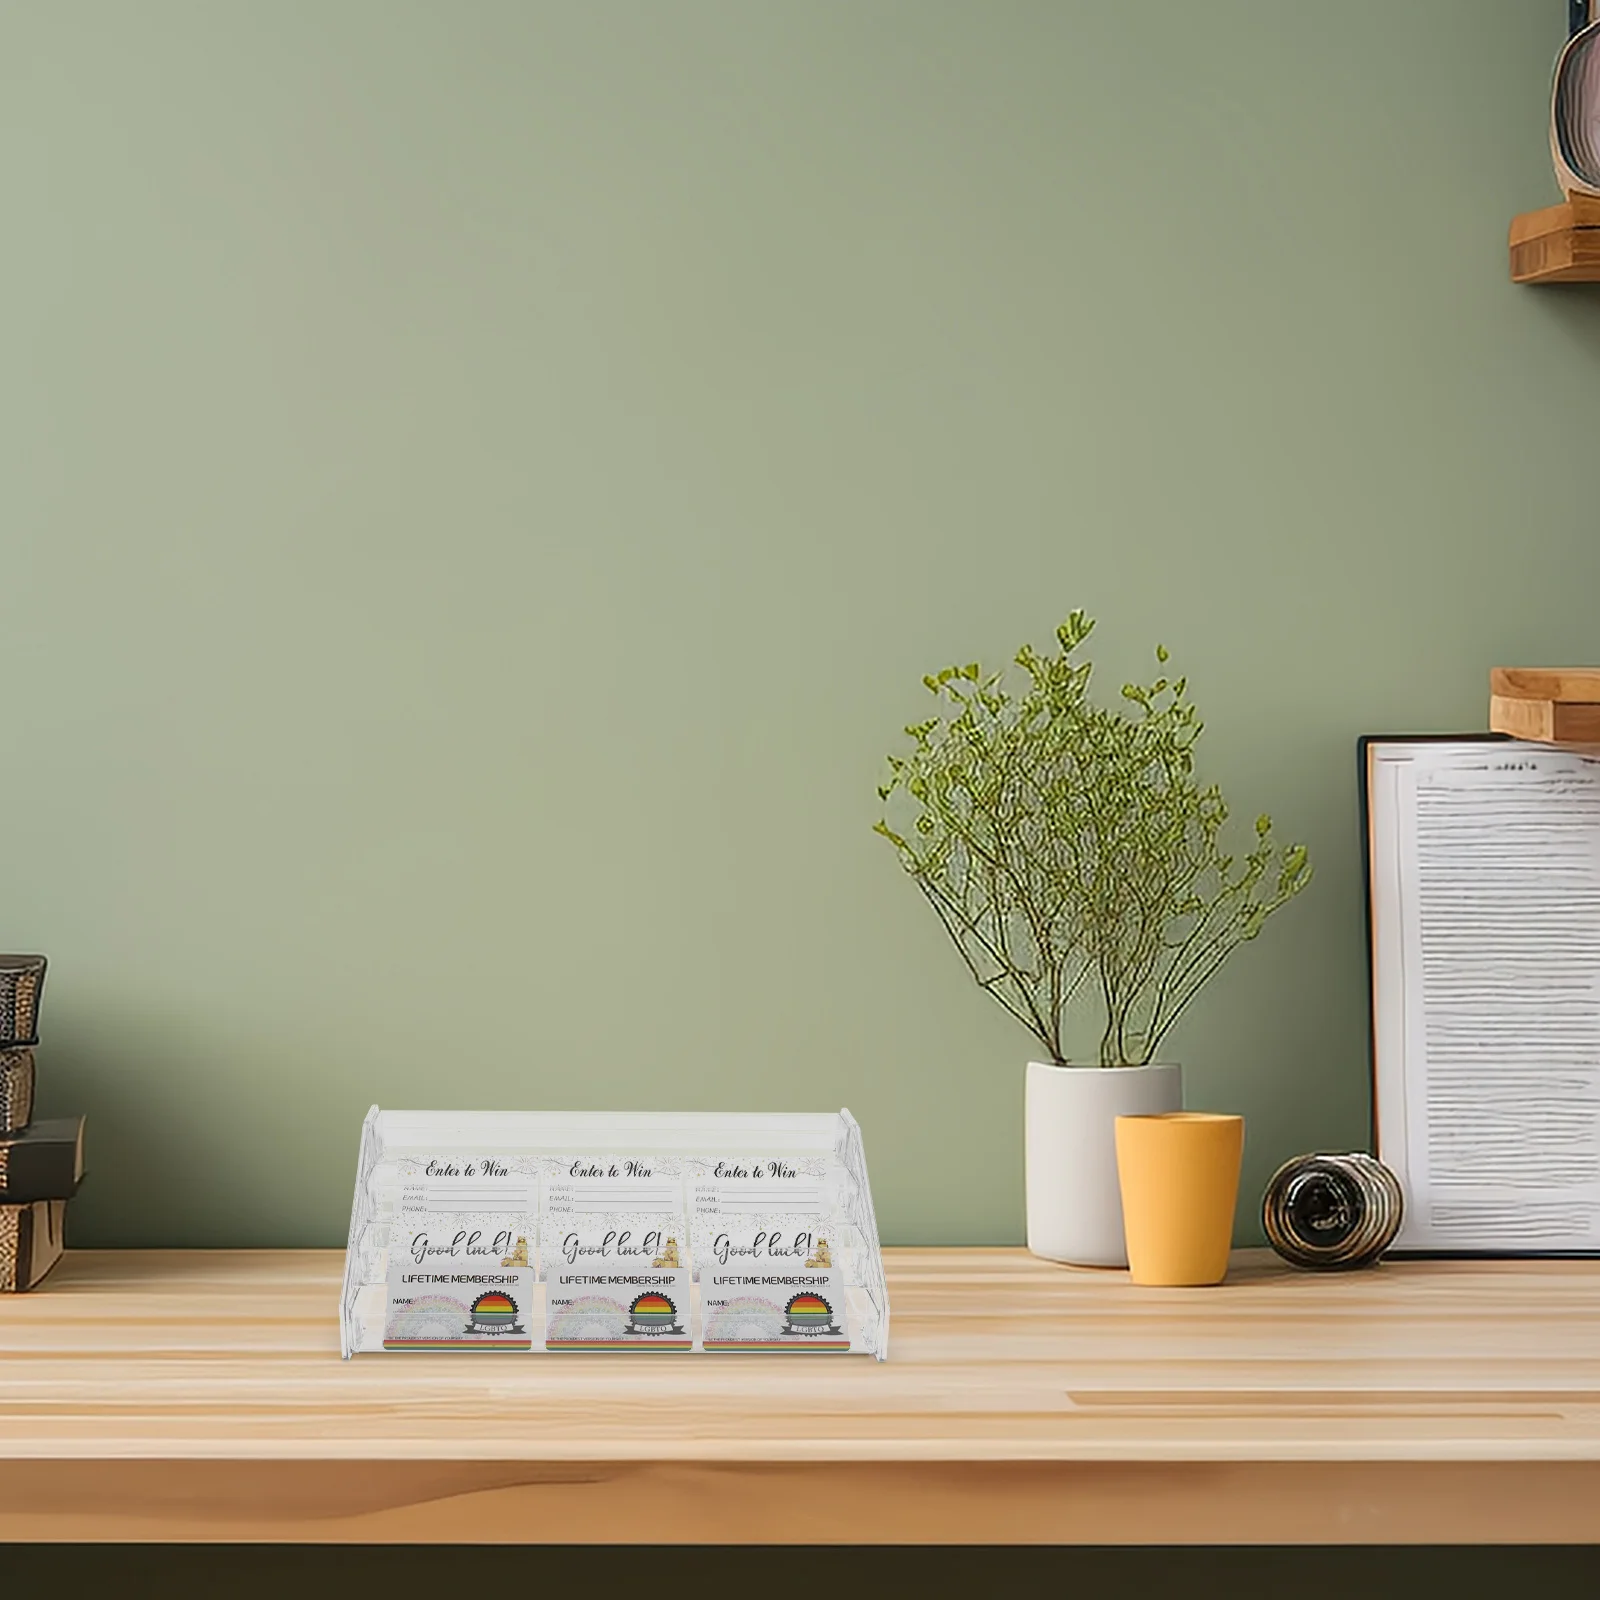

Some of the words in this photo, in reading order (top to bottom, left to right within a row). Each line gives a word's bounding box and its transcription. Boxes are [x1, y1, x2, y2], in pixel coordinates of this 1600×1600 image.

[425, 1160, 460, 1177] Enter
[464, 1163, 476, 1177] to
[480, 1160, 509, 1177] Win
[569, 1160, 605, 1177] Enter
[608, 1164, 620, 1177] to
[624, 1160, 653, 1177] Win
[713, 1161, 749, 1178] Enter
[752, 1165, 764, 1178] to
[767, 1161, 797, 1178] Win
[410, 1231, 467, 1264] Good
[466, 1230, 512, 1256] luck!
[562, 1231, 617, 1264] Good
[617, 1230, 662, 1256] luck!
[713, 1231, 767, 1265] Good
[768, 1231, 812, 1257] luck!
[402, 1274, 450, 1284] LIFETIME
[451, 1274, 519, 1284] MEMBERSHIP
[559, 1275, 607, 1285] LIFETIME
[608, 1275, 676, 1285] MEMBERSHIP
[713, 1276, 761, 1285] LIFETIME
[762, 1276, 830, 1285] MEMBERSHIP
